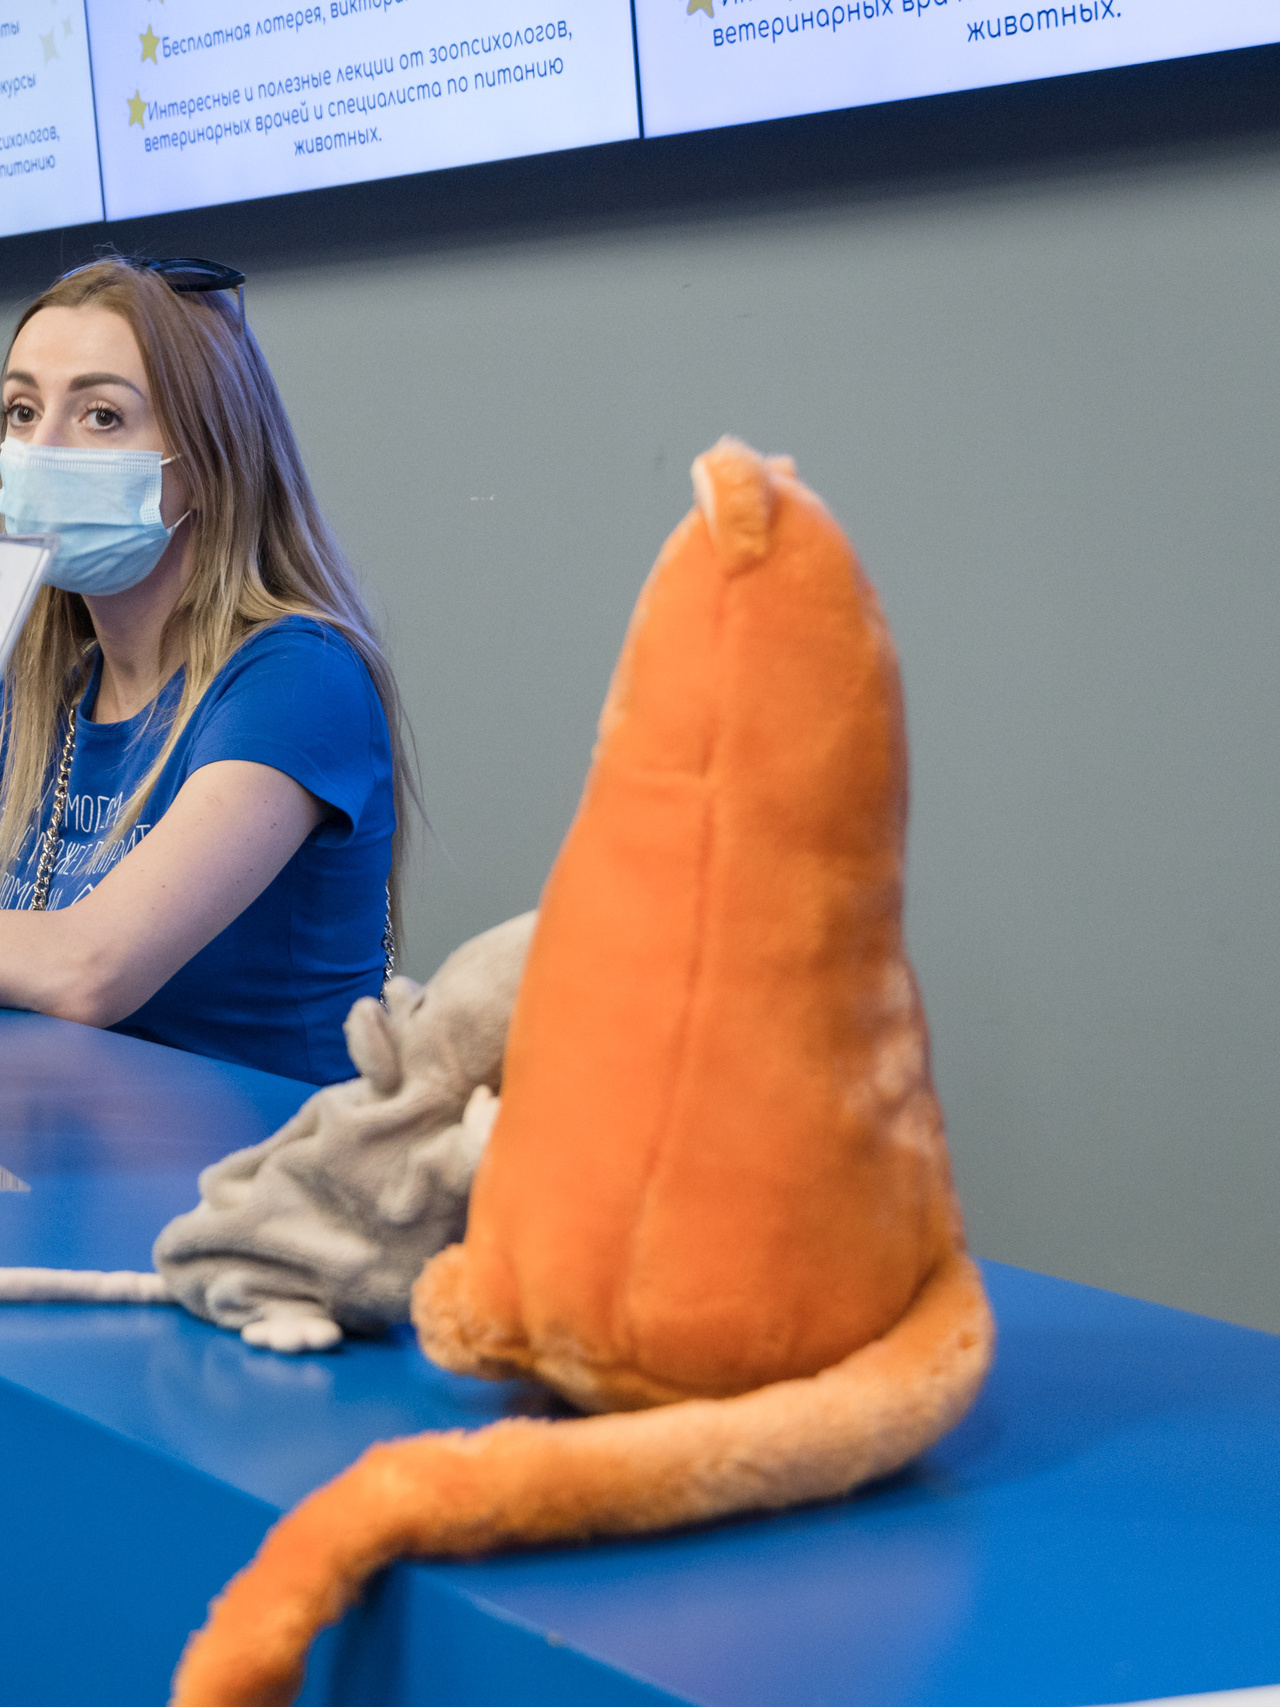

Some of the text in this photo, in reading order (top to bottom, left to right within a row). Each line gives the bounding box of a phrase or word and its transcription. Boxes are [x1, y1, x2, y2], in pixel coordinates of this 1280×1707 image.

[161, 22, 251, 59] Бесплатная
[255, 5, 326, 36] лотерея,
[713, 0, 894, 47] ветеринарных
[967, 0, 1122, 42] животных.
[147, 19, 573, 122] Интересные и полезные лекции от зоопсихологов,
[144, 57, 565, 152] ветеринарных врачей и специалиста по питанию
[293, 124, 383, 156] животных.
[0, 155, 56, 178] питанию
